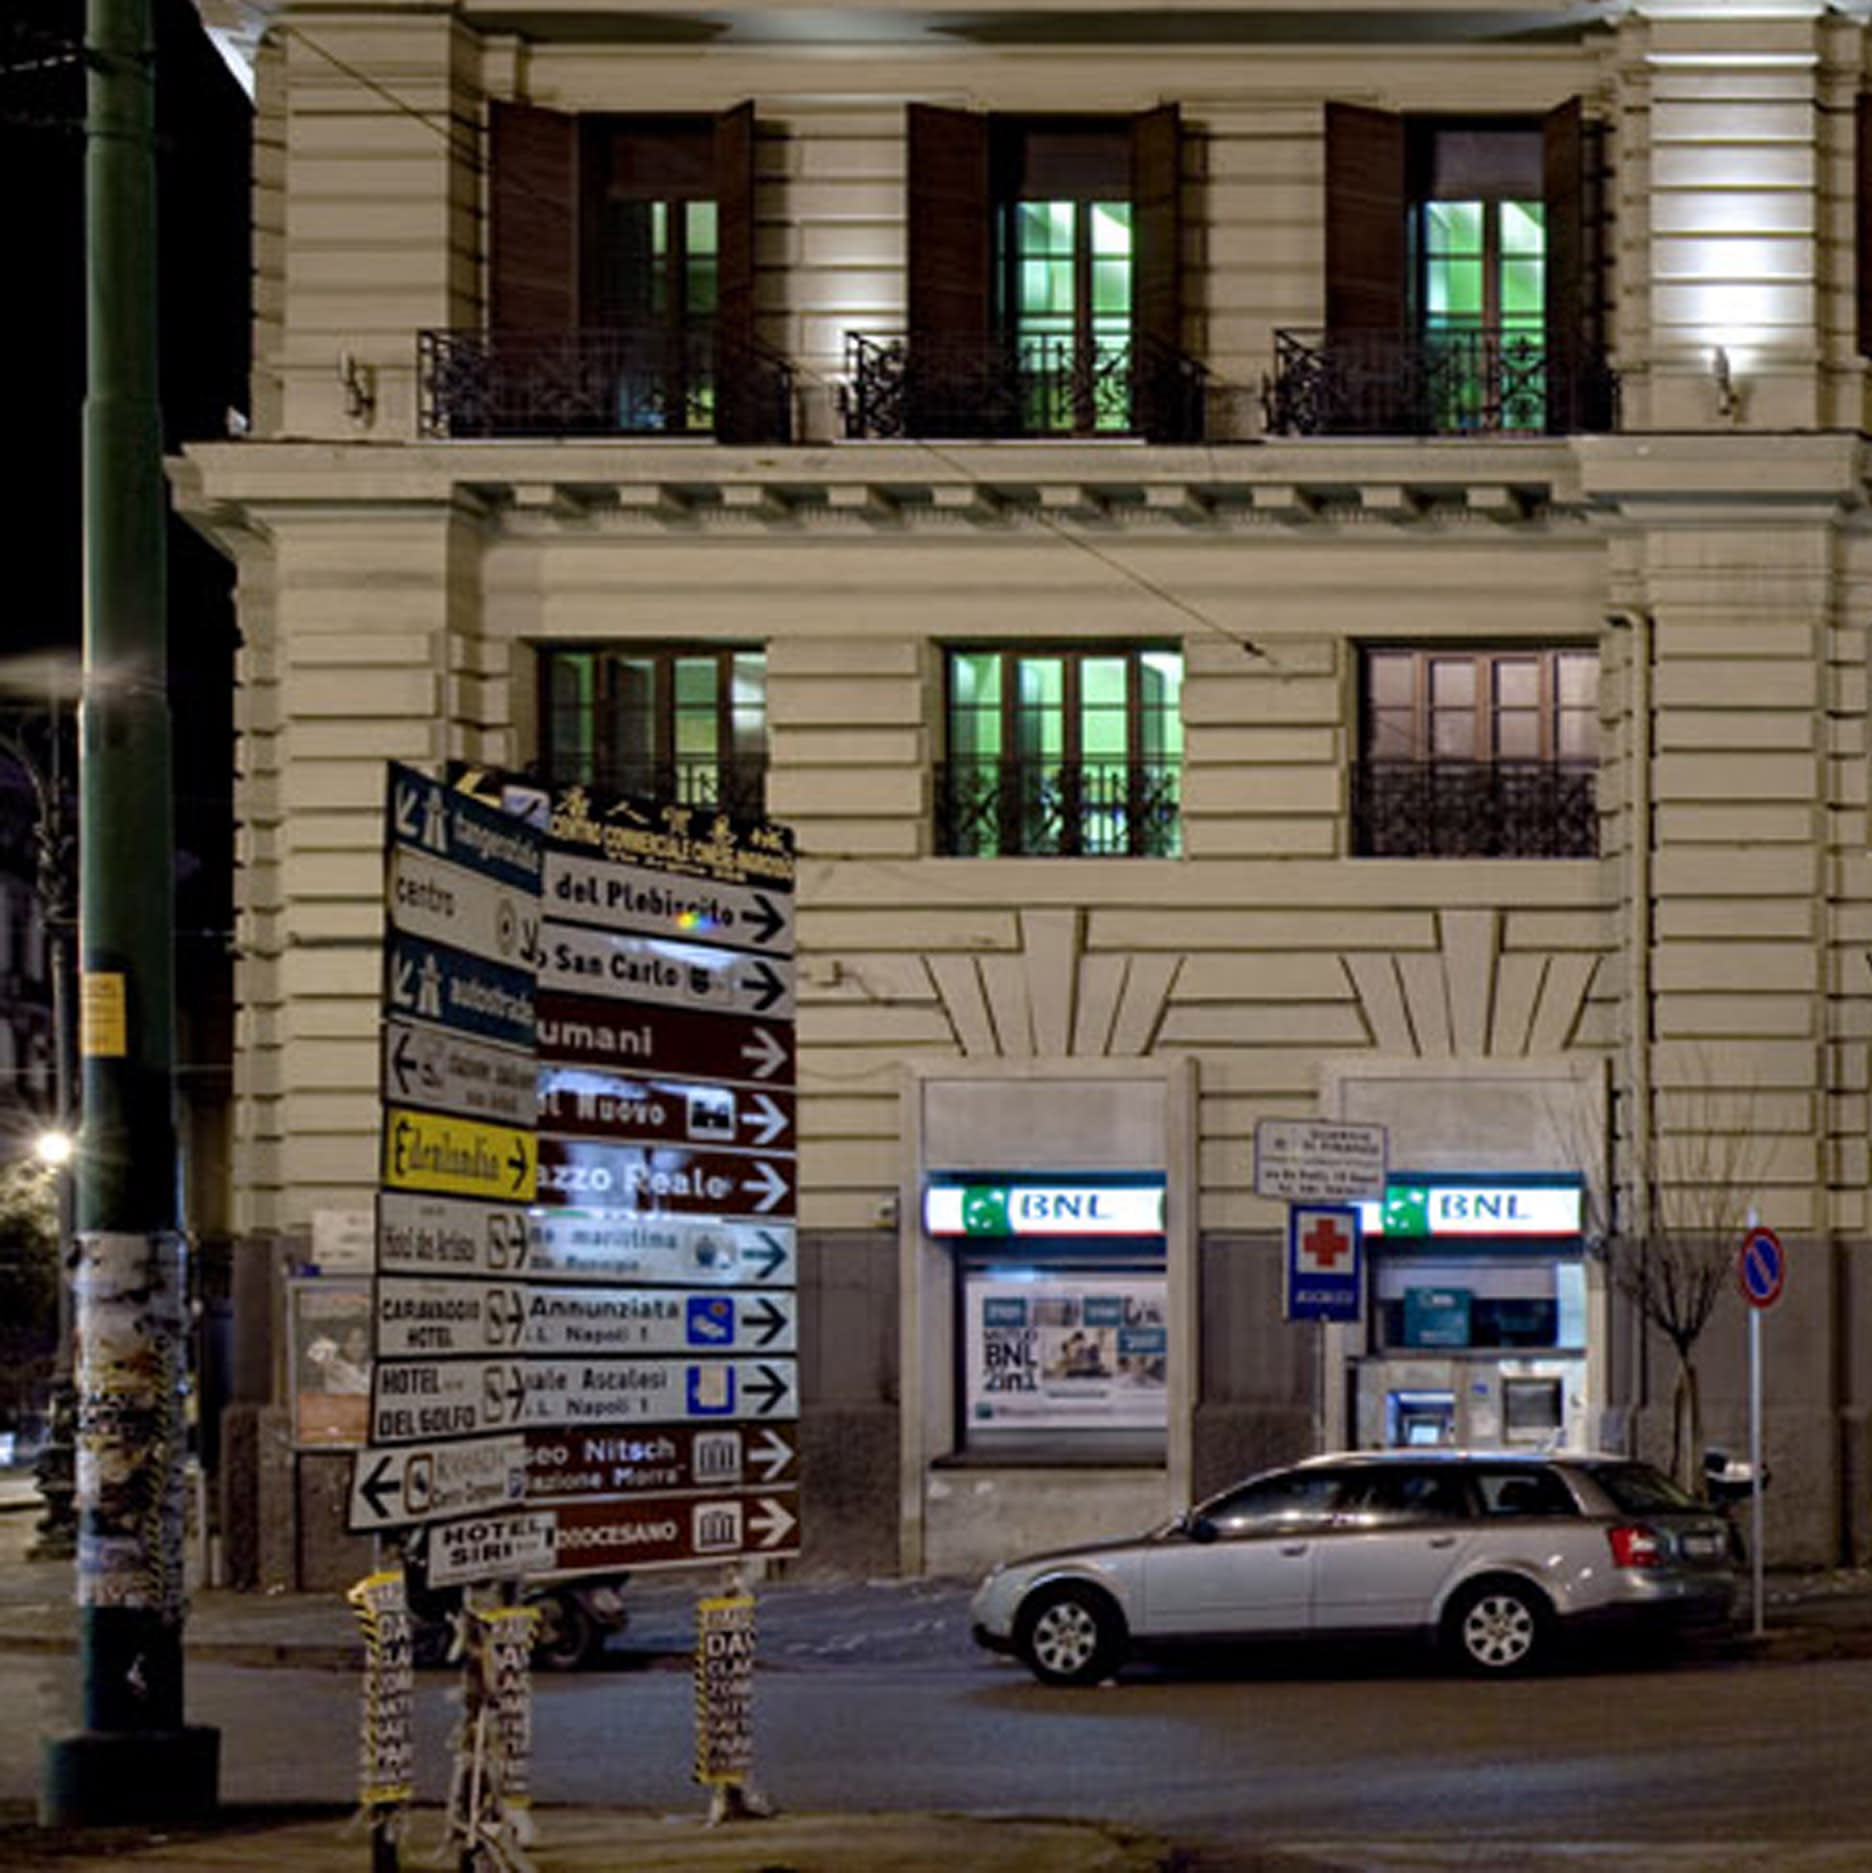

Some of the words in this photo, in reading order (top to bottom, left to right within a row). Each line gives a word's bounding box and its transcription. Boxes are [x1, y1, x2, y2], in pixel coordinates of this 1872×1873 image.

[396, 877, 454, 917] centro
[555, 873, 598, 906] del
[607, 879, 735, 926] Plebiscito
[554, 944, 604, 976] San
[610, 954, 680, 985] Carlo
[1020, 1193, 1113, 1220] BNL
[1440, 1193, 1532, 1220] BNL
[529, 1296, 680, 1319] Annunziata
[566, 1327, 630, 1344] Napoli
[985, 1342, 1038, 1368] BNL
[381, 1366, 440, 1395] HOTEL
[581, 1367, 667, 1390] Ascalesi
[983, 1367, 1038, 1392] 2in1
[566, 1399, 630, 1416] Napoli
[379, 1409, 415, 1437] DEL
[583, 1435, 677, 1463] Nitsch
[443, 1518, 537, 1547] HOTEL
